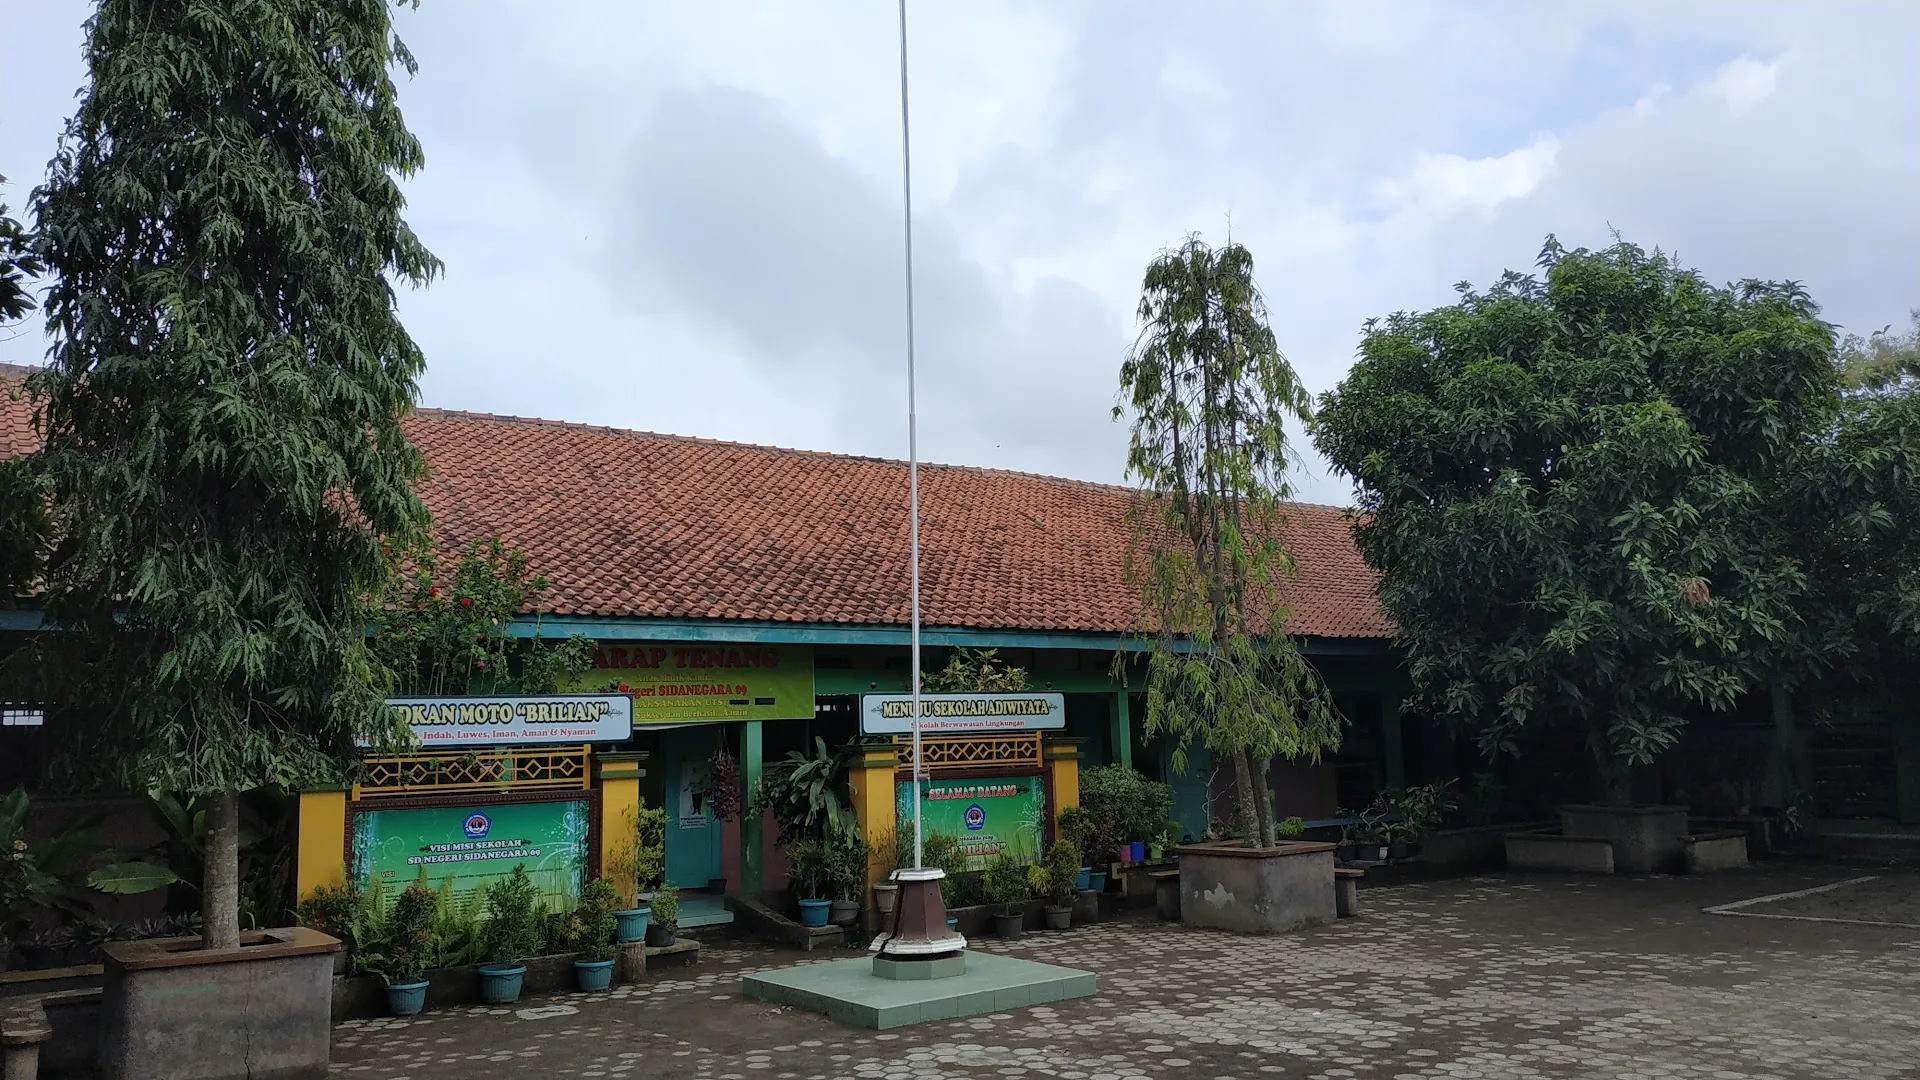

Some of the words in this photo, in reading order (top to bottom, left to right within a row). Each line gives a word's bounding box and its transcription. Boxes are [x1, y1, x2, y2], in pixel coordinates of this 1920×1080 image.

[592, 648, 667, 669] ARAP
[673, 647, 779, 669] TENANG
[624, 685, 656, 699] egeri
[658, 684, 733, 697] SIDANEGARA
[736, 685, 748, 697] 09
[634, 698, 703, 709] LAKSANAKAN
[933, 699, 987, 717] SEKOLAH
[987, 698, 1050, 716] ADIWIYATA
[391, 704, 457, 726] DKAN
[458, 702, 512, 725] MOTO
[635, 709, 663, 720] Sukses
[665, 709, 681, 719] dan
[911, 721, 939, 729] Skolah
[940, 720, 984, 728] Berwawasan
[985, 720, 1025, 729] Lingkungan
[423, 730, 455, 741] Indah,
[457, 729, 490, 740] Luwes,
[492, 729, 519, 740] Iman,
[521, 728, 548, 738] Aman
[550, 728, 558, 737] &
[560, 727, 597, 738] Nyaman
[929, 786, 976, 800] SELAMAT
[977, 784, 1017, 799] DATANG
[430, 844, 450, 853] VISI
[452, 842, 474, 852] MISI
[476, 839, 522, 851] SEKOLAH
[407, 856, 421, 866] SD
[423, 854, 463, 865] NEGERI
[464, 850, 528, 861] SIDANEGARA
[530, 848, 541, 858] 09
